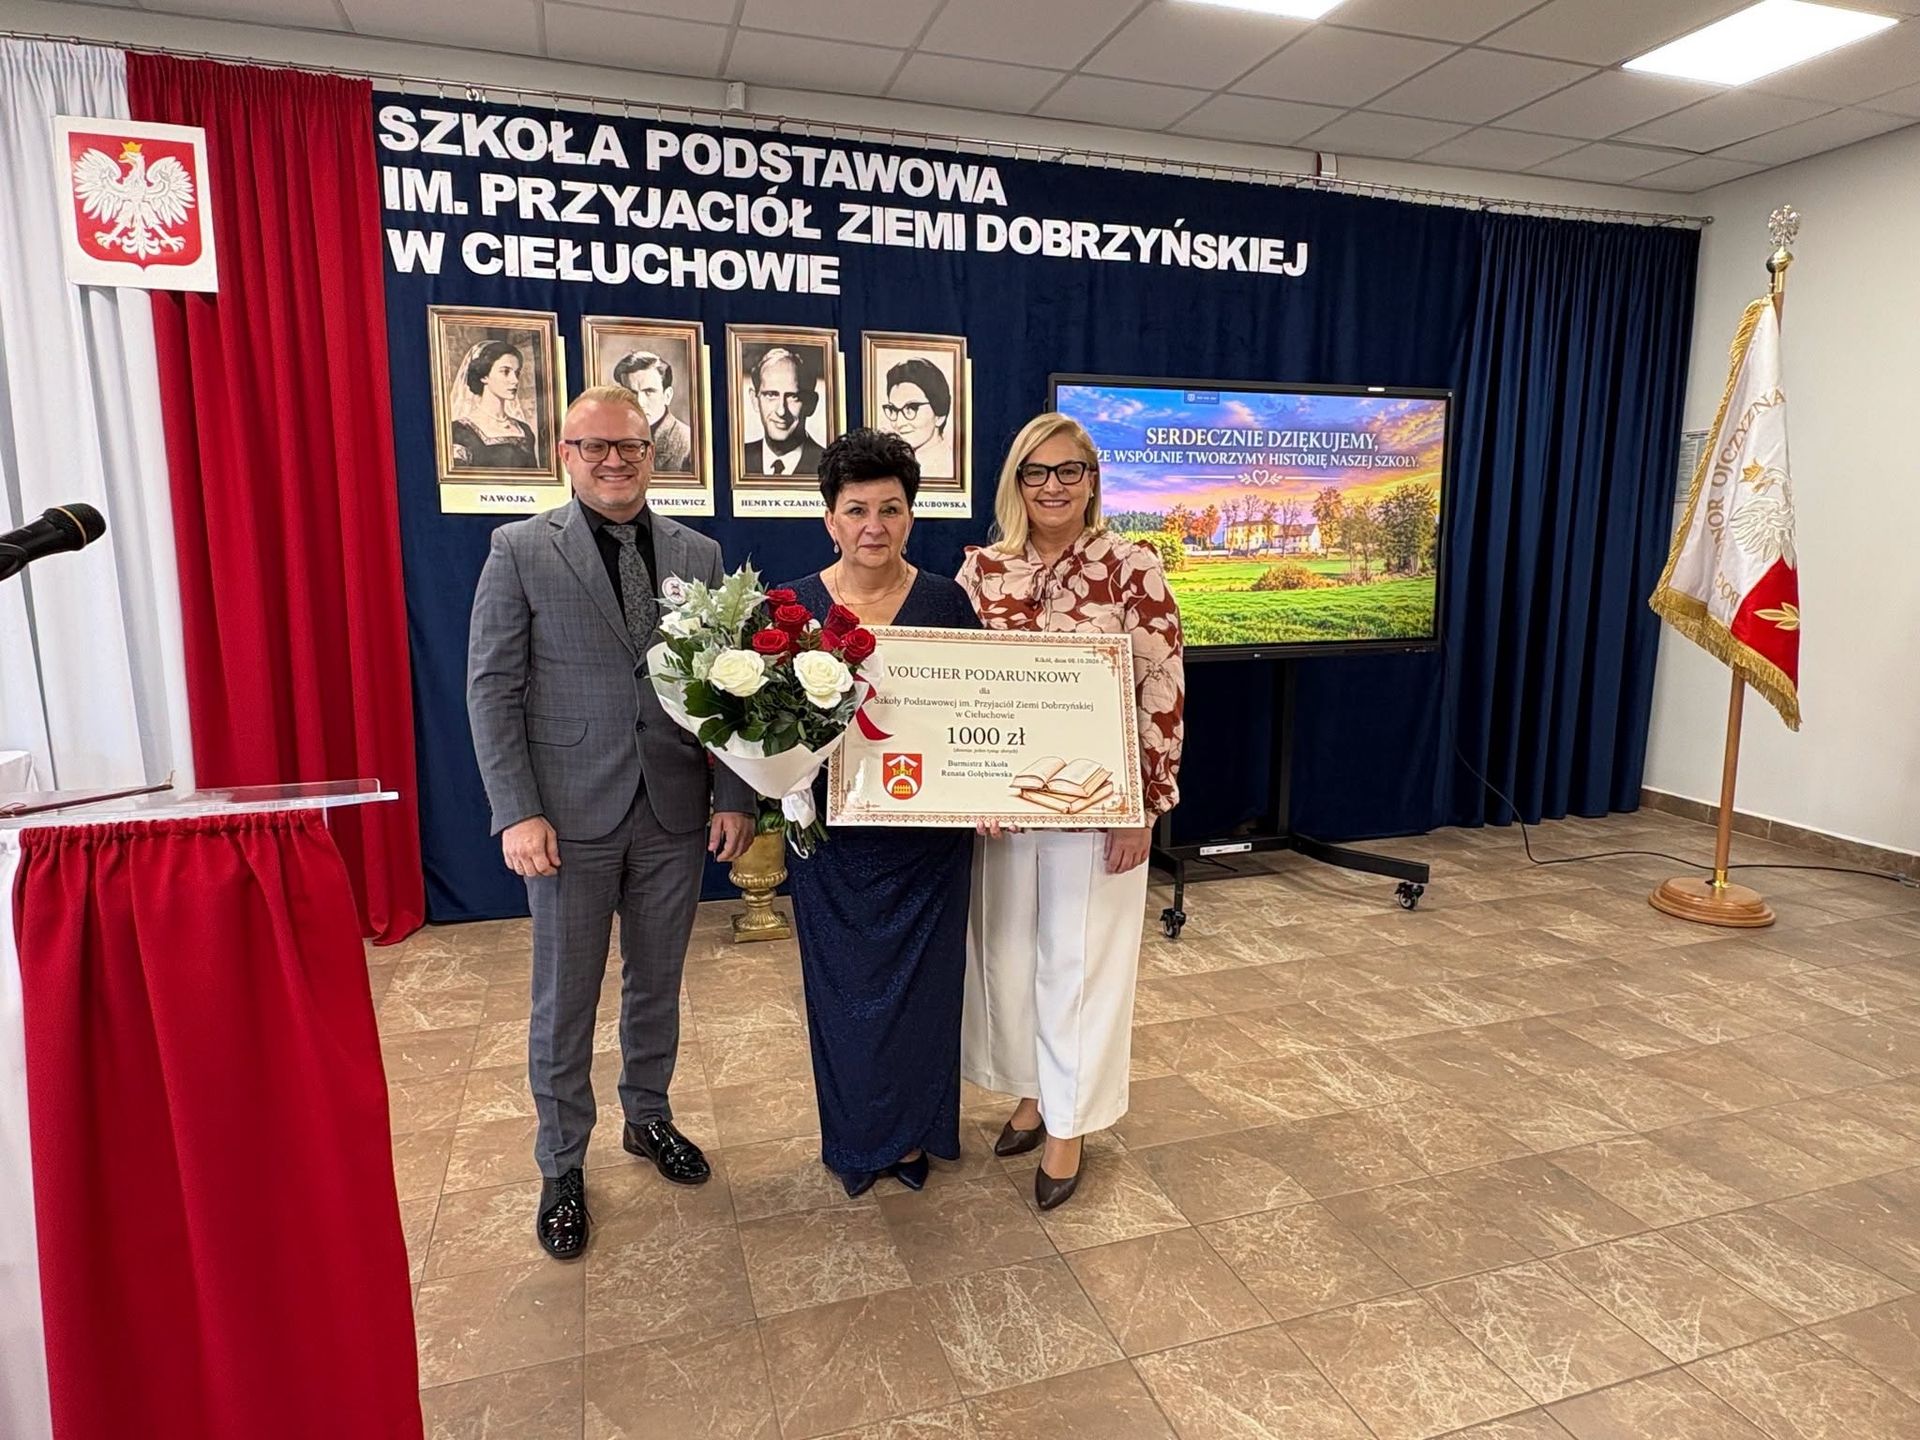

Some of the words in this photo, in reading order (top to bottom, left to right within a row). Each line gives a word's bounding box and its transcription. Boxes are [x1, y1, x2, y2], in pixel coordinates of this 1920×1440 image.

[378, 105, 630, 169] SZKOŁA
[646, 128, 1008, 206] PODSTAWOWA
[382, 166, 468, 216] IM.
[481, 172, 822, 240] PRZYJACIÓŁ
[837, 202, 966, 251] ZIEMI
[976, 217, 1308, 277] DOBRZYŃSKIEJ
[386, 229, 445, 275] W
[461, 231, 841, 295] CIEŁUCHOWIE
[1146, 428, 1263, 448] SERDECZNIE
[1268, 431, 1379, 452] DZIĘKUJEMY,
[1712, 388, 1786, 488] OJCZYZNA
[1113, 448, 1184, 465] WSPÓLNIE
[1186, 451, 1266, 466] TWORZYMY
[1269, 453, 1327, 469] HISTORIĘ
[1330, 454, 1373, 469] NASZEJ
[480, 495, 535, 503] NAWOJKA
[741, 499, 781, 507] HENRYK
[1708, 496, 1725, 565] NOR
[888, 666, 961, 680] VOUCHER
[965, 669, 1081, 683] PODARUNKOWY
[904, 697, 957, 708] Podstawowej
[1016, 701, 1039, 709] Ziemi
[947, 727, 1000, 745] 1000
[1007, 727, 1026, 745] zł
